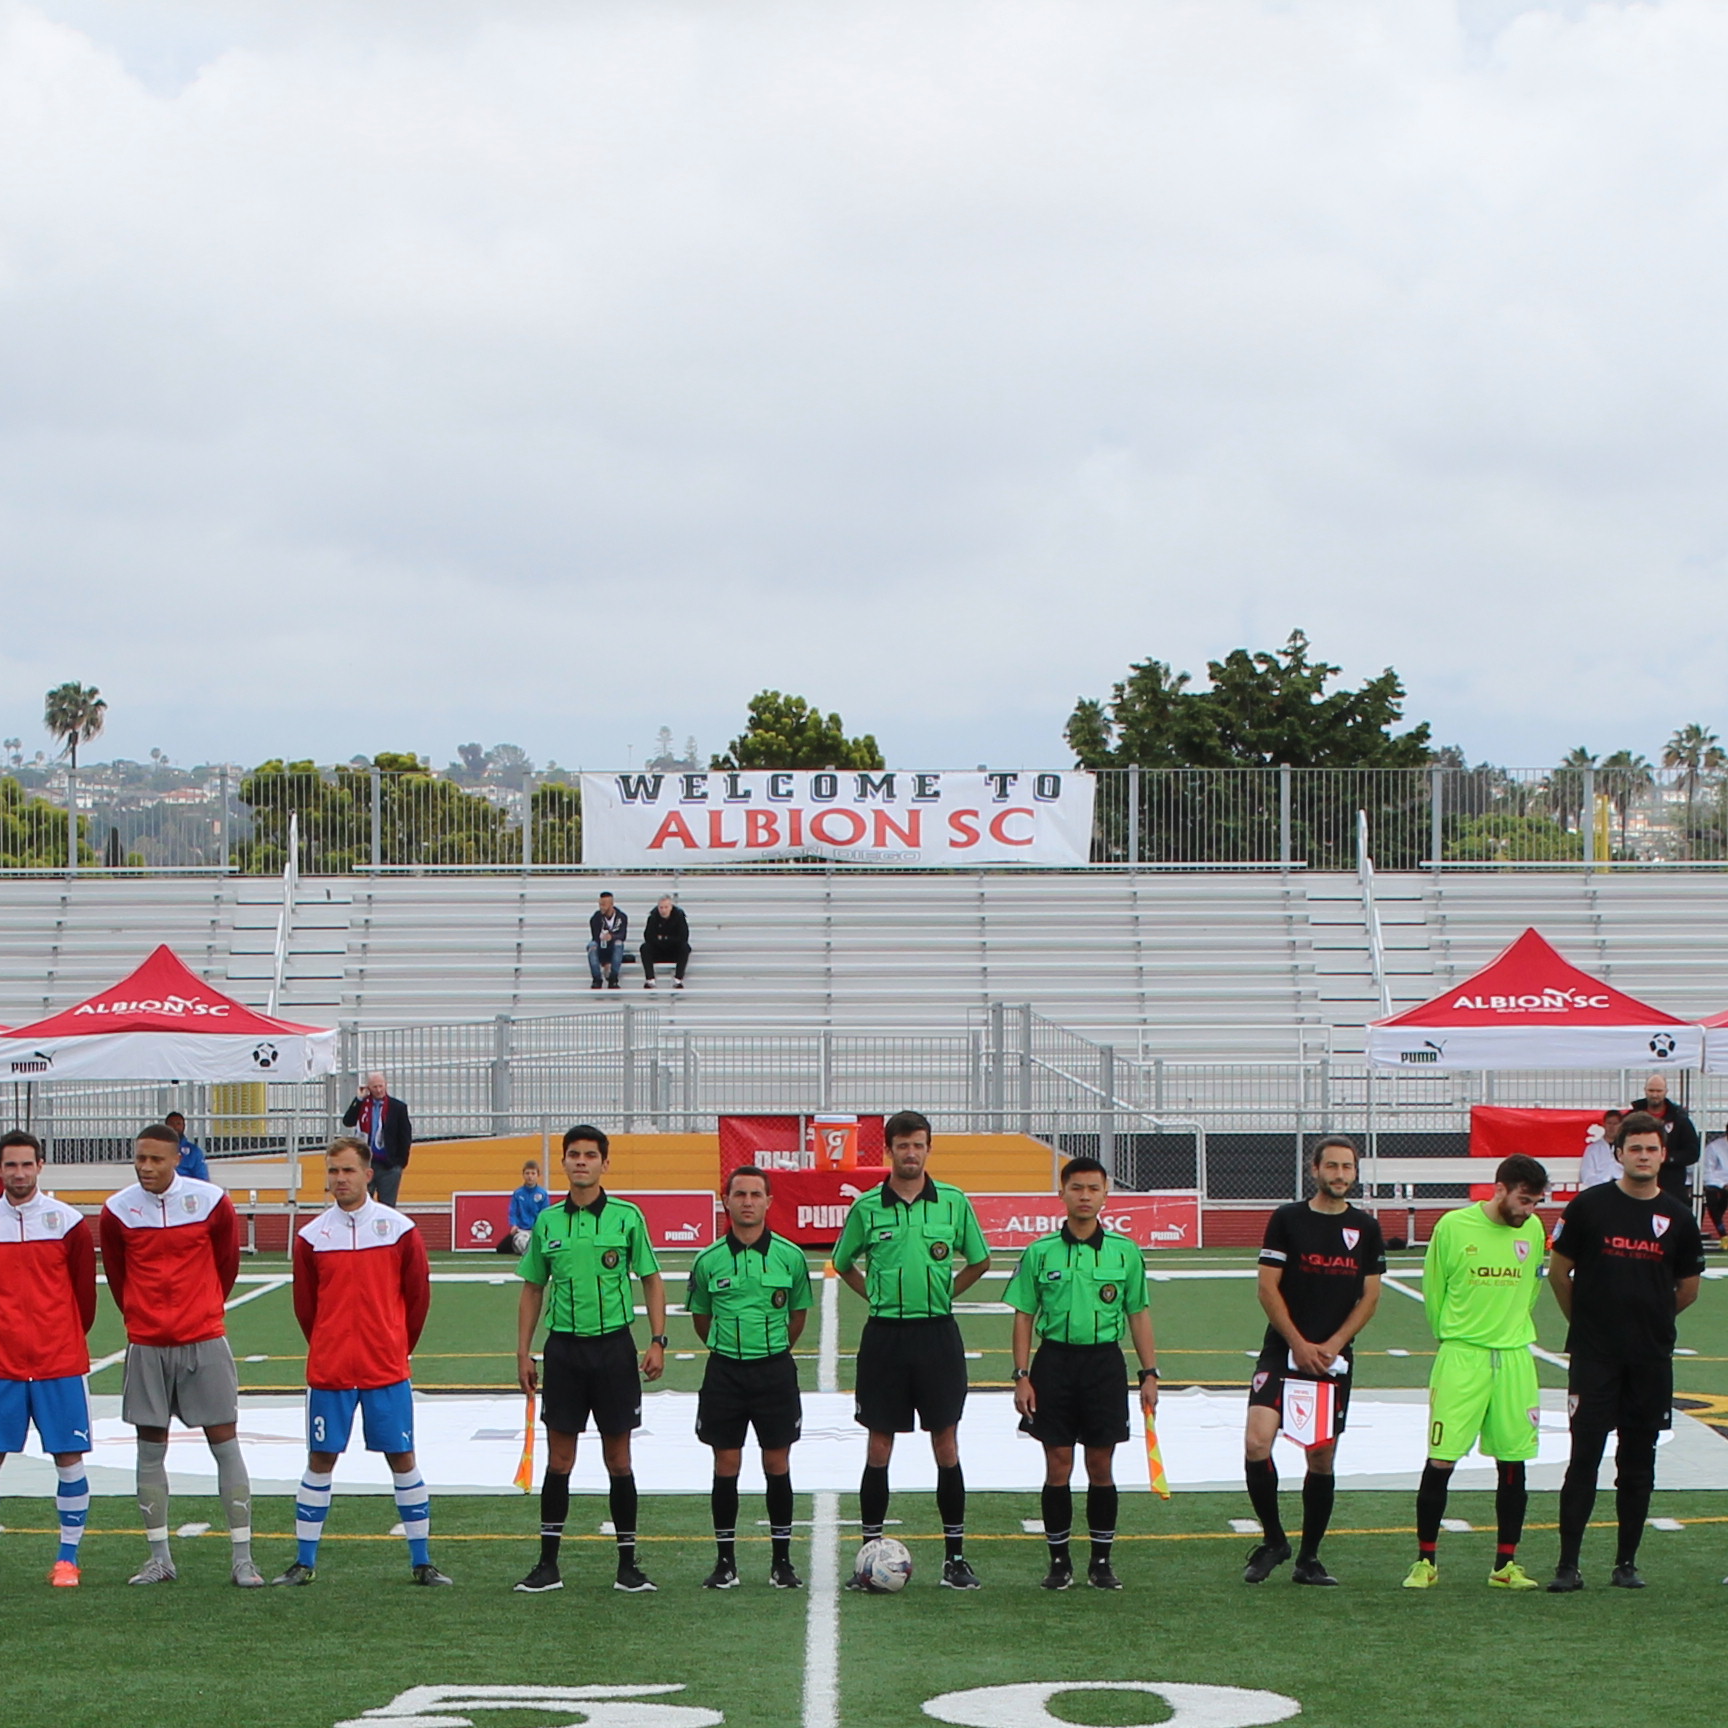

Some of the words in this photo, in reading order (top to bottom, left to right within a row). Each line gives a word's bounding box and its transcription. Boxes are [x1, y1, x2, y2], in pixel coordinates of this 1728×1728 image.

[615, 773, 941, 804] WELCOME
[985, 772, 1062, 802] TO
[646, 808, 922, 849] ALBION
[948, 808, 1035, 848] SC
[833, 849, 921, 862] DIEGO
[74, 1000, 184, 1016] ALBION
[193, 1004, 230, 1017] SC
[1453, 996, 1564, 1008] ALBION
[1573, 996, 1610, 1008] SC
[1401, 1052, 1437, 1063] PUMA
[11, 1061, 47, 1074] PUMA
[828, 1131, 842, 1146] G
[797, 1205, 851, 1229] PUM
[1104, 1216, 1132, 1232] SC
[665, 1231, 697, 1241] PUMA
[1612, 1237, 1664, 1255] QUAIL
[1308, 1253, 1359, 1270] QUAIL
[1478, 1266, 1522, 1279] QUAIL
[1494, 1279, 1520, 1287] ESTAT
[314, 1416, 325, 1442] 3
